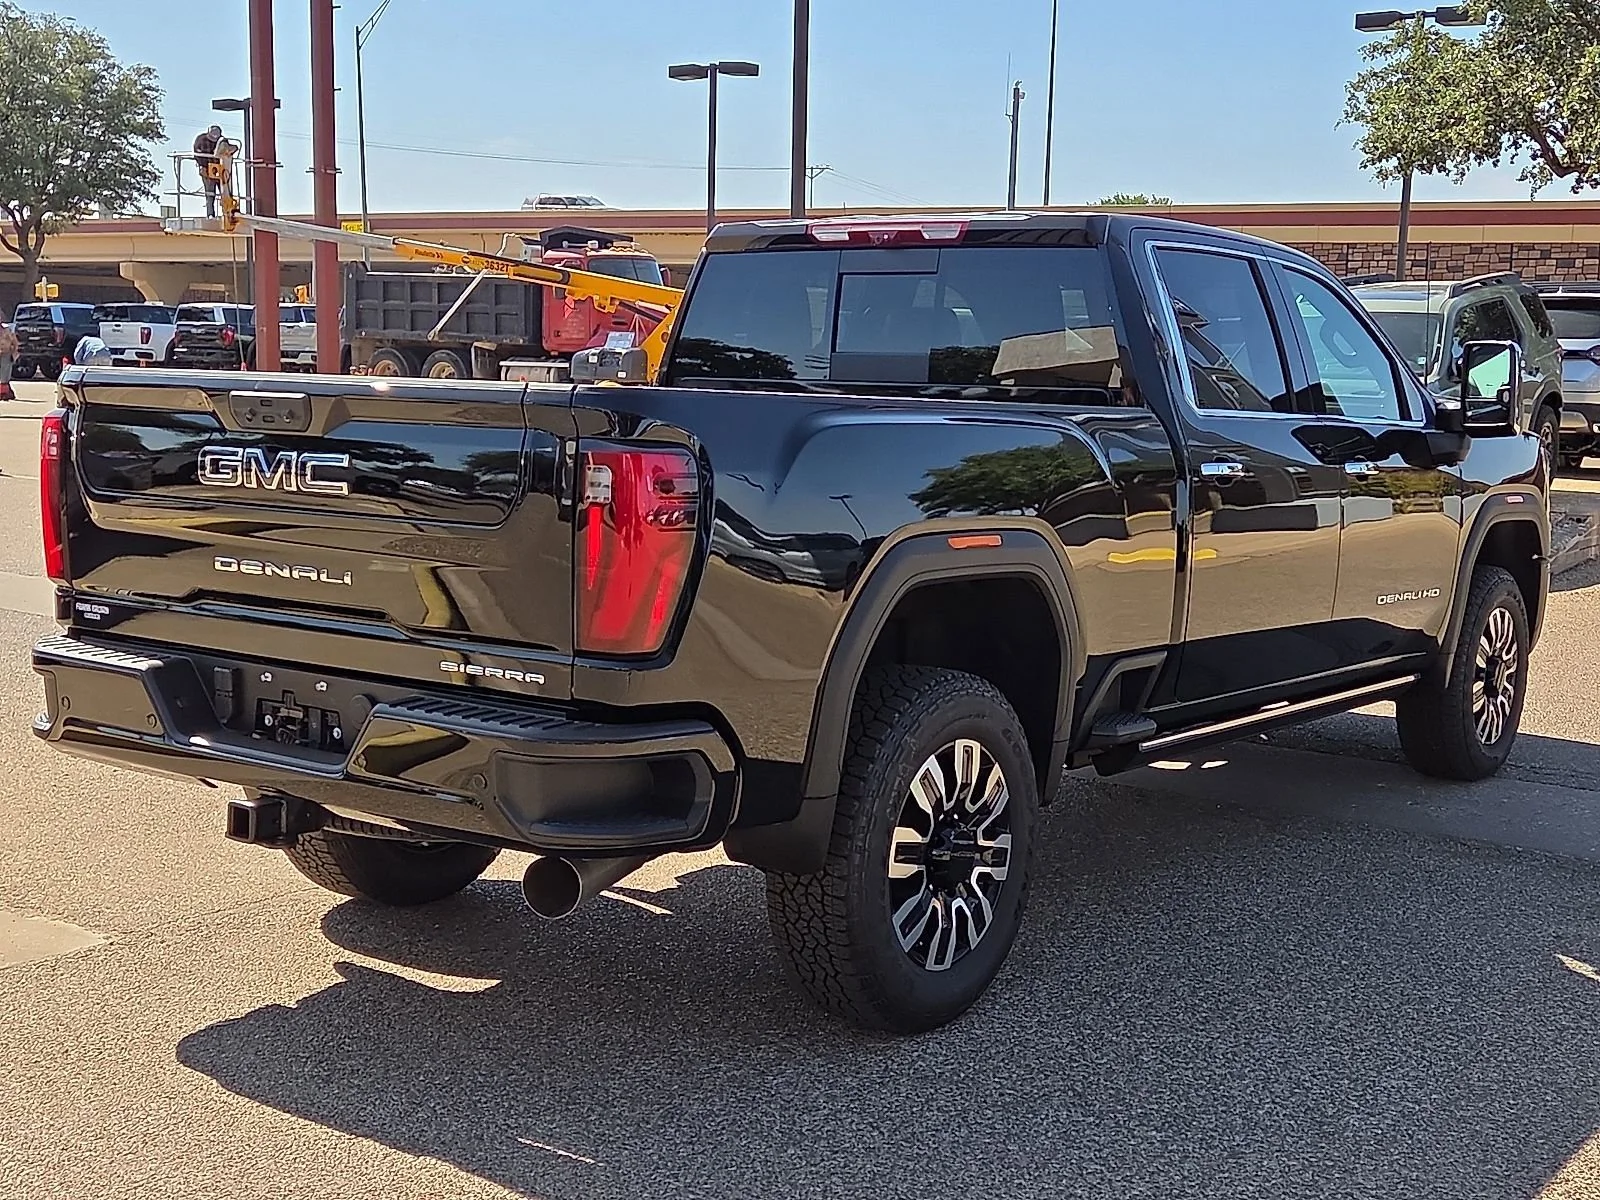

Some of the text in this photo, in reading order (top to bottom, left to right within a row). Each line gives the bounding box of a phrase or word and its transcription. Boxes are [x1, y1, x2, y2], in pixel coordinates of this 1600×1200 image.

[484, 260, 509, 273] 3632T
[198, 445, 349, 496] GMC
[213, 556, 352, 585] DENALI
[1377, 588, 1440, 605] DENALI HD
[439, 661, 545, 684] SIERRA
